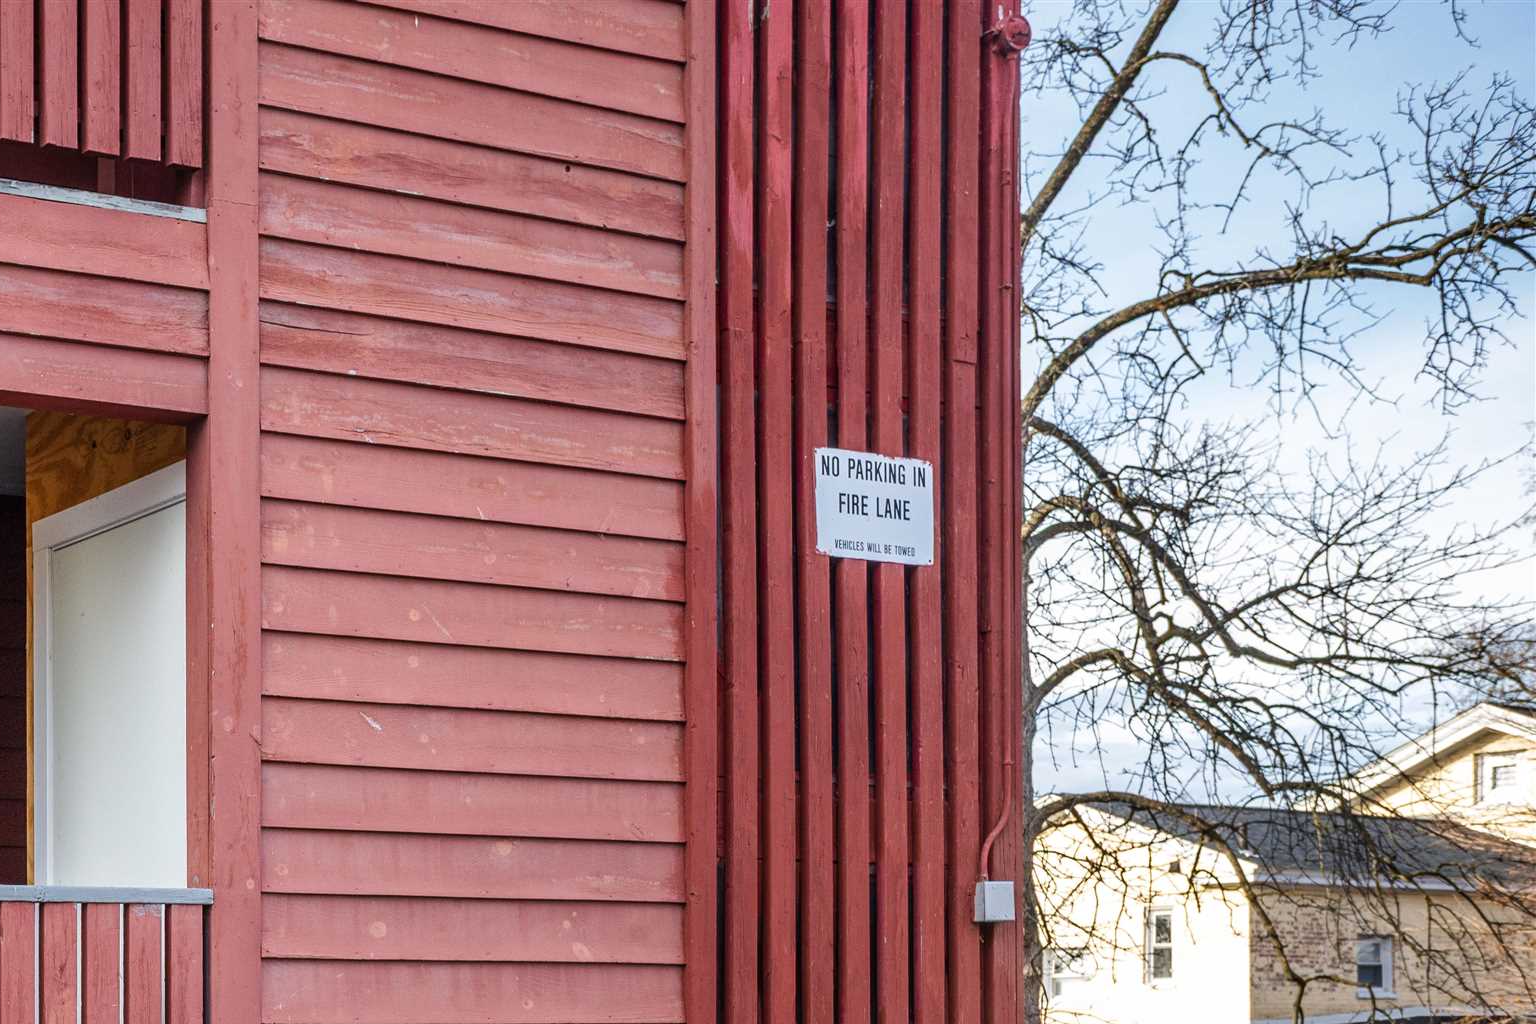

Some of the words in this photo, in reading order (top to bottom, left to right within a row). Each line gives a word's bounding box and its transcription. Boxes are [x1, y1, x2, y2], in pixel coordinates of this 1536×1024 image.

[821, 455, 840, 477] NO
[848, 458, 906, 485] PARKING
[913, 467, 926, 487] IN
[839, 493, 868, 516] FIRE
[876, 497, 911, 521] LANE
[834, 539, 864, 552] VEHICLES
[867, 542, 881, 554] WILL
[884, 544, 892, 555] BE
[895, 545, 916, 557] TOWED
